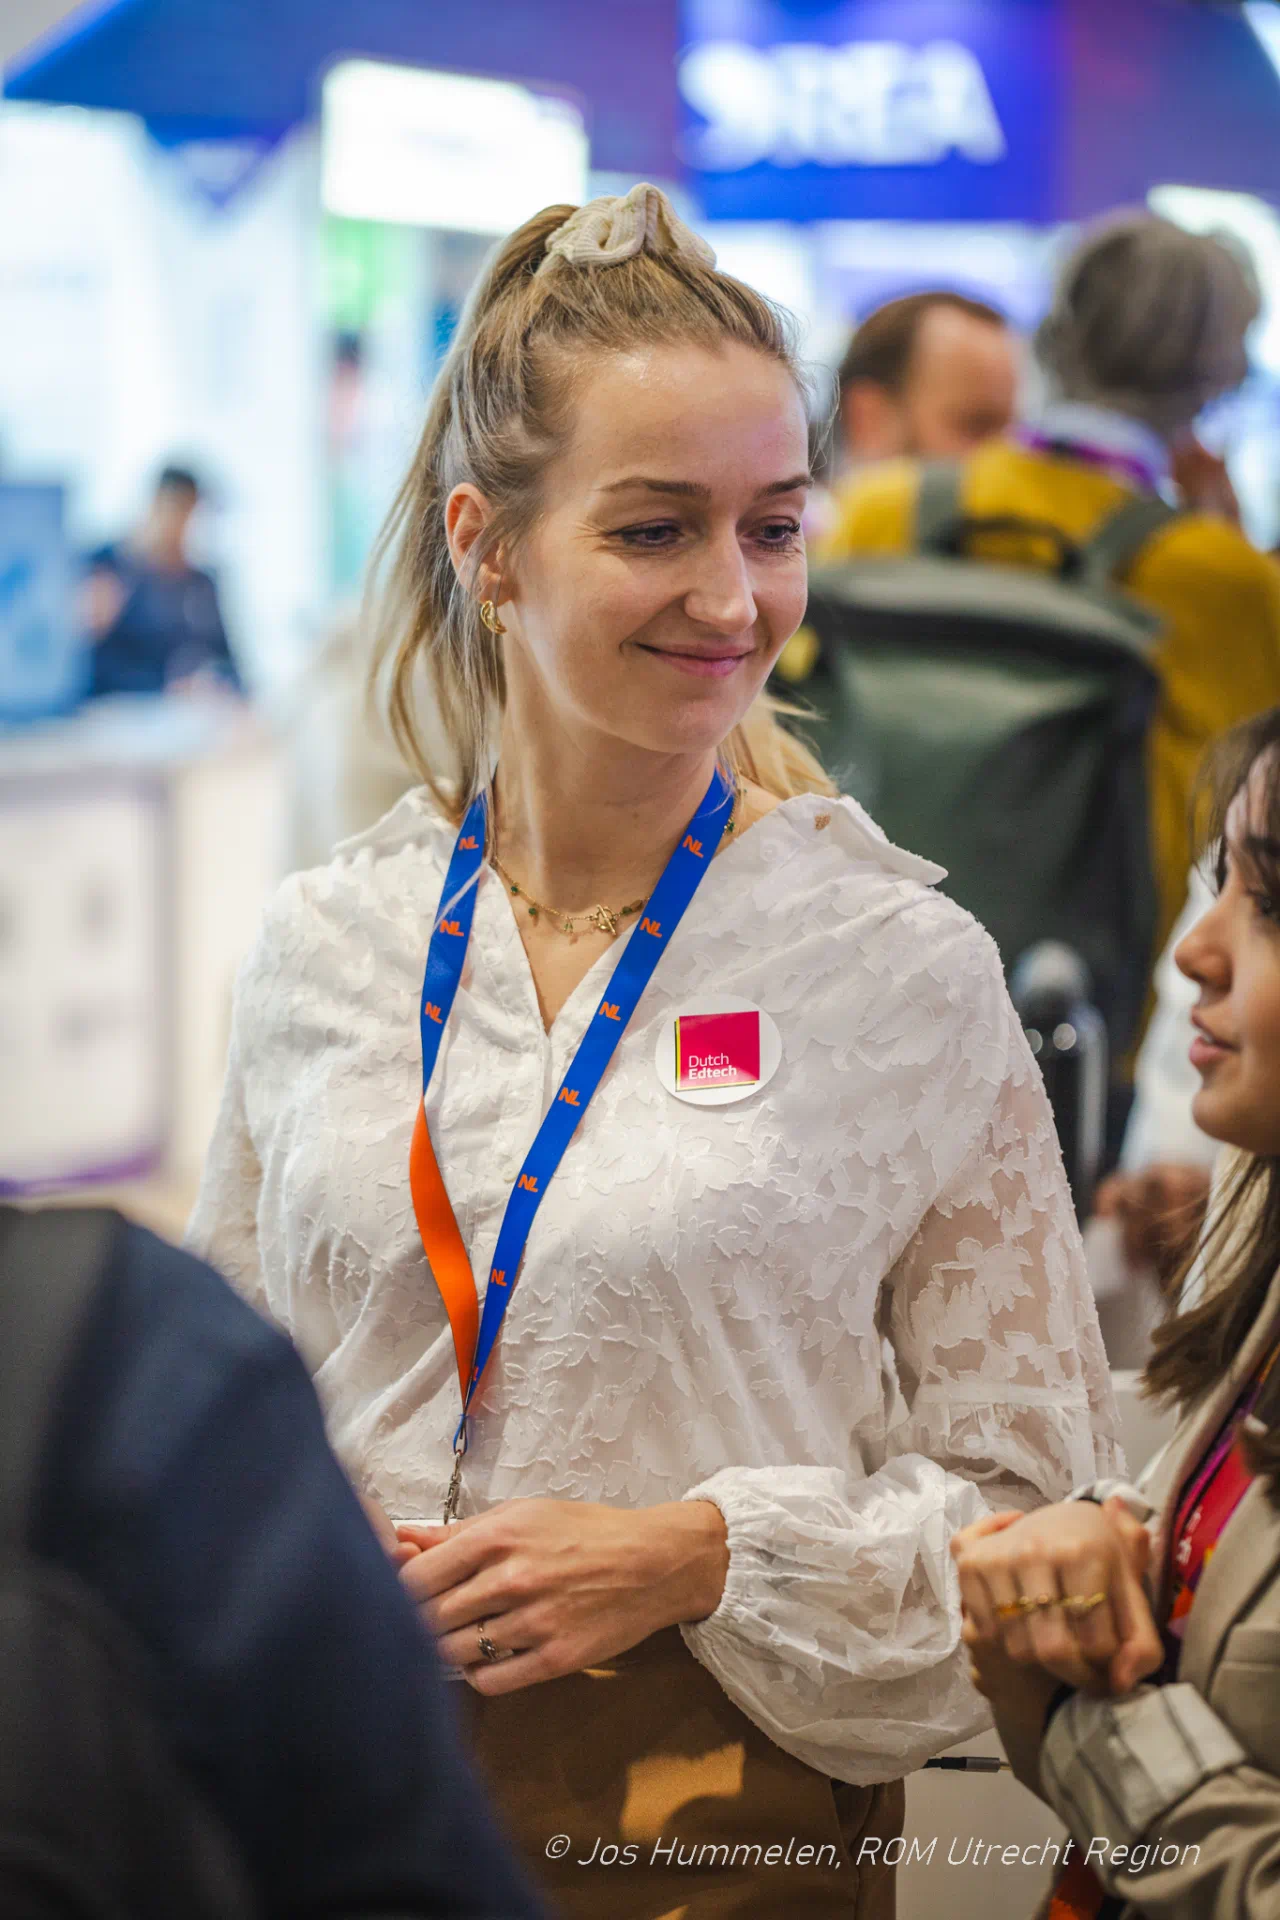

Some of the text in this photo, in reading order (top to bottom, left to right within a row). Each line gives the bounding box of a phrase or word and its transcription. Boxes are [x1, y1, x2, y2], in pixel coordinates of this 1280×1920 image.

[458, 835, 479, 851] NL
[682, 835, 704, 857] NL
[439, 919, 464, 937] NL
[640, 917, 663, 938] NL
[424, 1001, 443, 1024] NL
[598, 1001, 622, 1021] NL
[688, 1053, 729, 1068] Dutch
[688, 1065, 737, 1080] Edtech
[558, 1087, 581, 1106] NL
[517, 1174, 539, 1192] NL
[490, 1268, 508, 1287] NL
